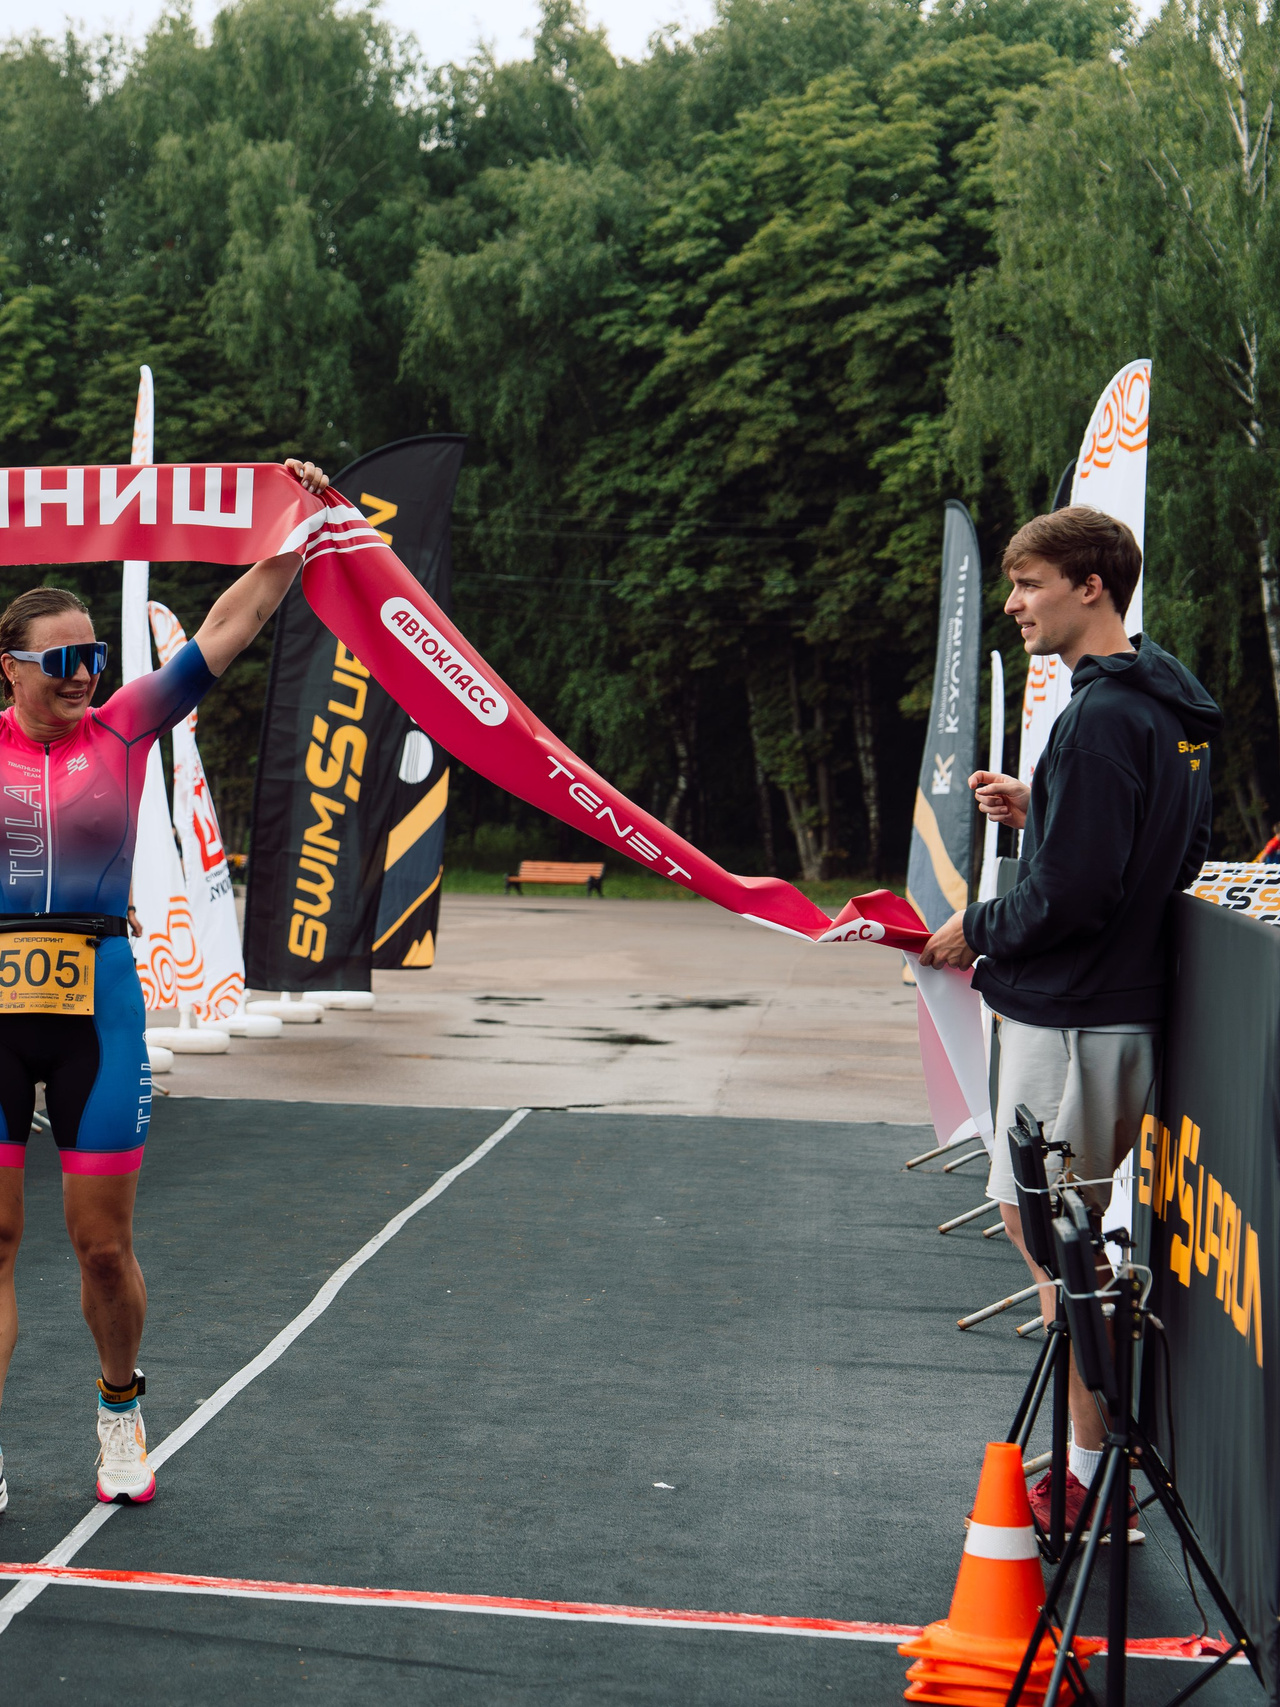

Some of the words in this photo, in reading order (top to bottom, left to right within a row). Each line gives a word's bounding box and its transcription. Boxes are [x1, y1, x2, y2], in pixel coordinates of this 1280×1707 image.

[390, 609, 498, 714] АВТОКЛАСС
[7, 761, 41, 773] TRIATHLON
[23, 770, 41, 779] TEAM
[3, 785, 44, 885] TULA
[547, 755, 692, 881] TENET
